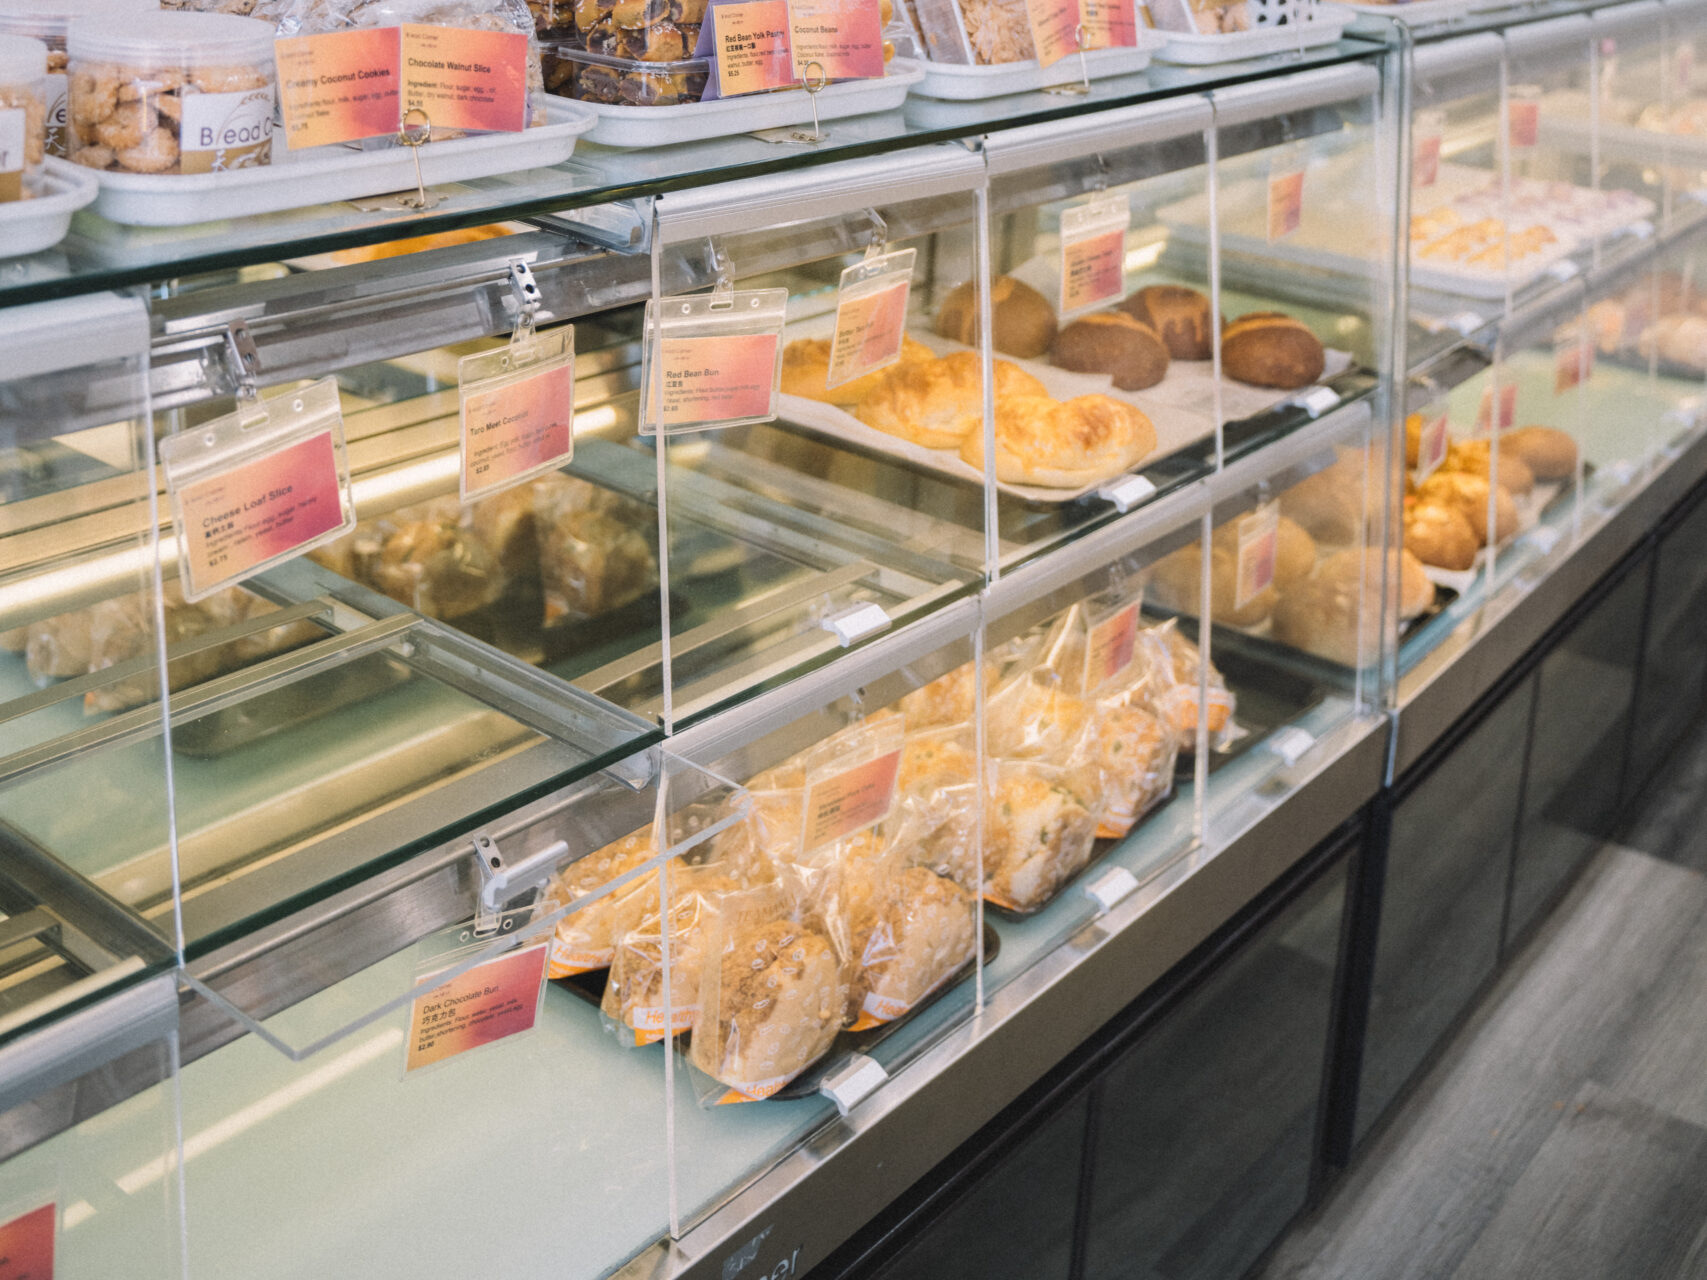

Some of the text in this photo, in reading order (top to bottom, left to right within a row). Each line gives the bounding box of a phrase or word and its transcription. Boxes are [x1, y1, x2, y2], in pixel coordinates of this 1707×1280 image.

[725, 35, 737, 43] Red
[737, 33, 752, 41] Bean
[408, 57, 491, 73] Chocolate Walnut Slice
[320, 72, 356, 84] Coconut
[358, 68, 390, 80] Cookies
[200, 121, 262, 147] Bread
[666, 368, 719, 379] Red Bean Bun
[203, 507, 241, 528] Cheese
[243, 495, 267, 512] Loaf
[268, 484, 293, 501] Slice
[423, 1003, 442, 1015] Dark
[443, 990, 482, 1008] Chocolate
[483, 985, 499, 996] Bun
